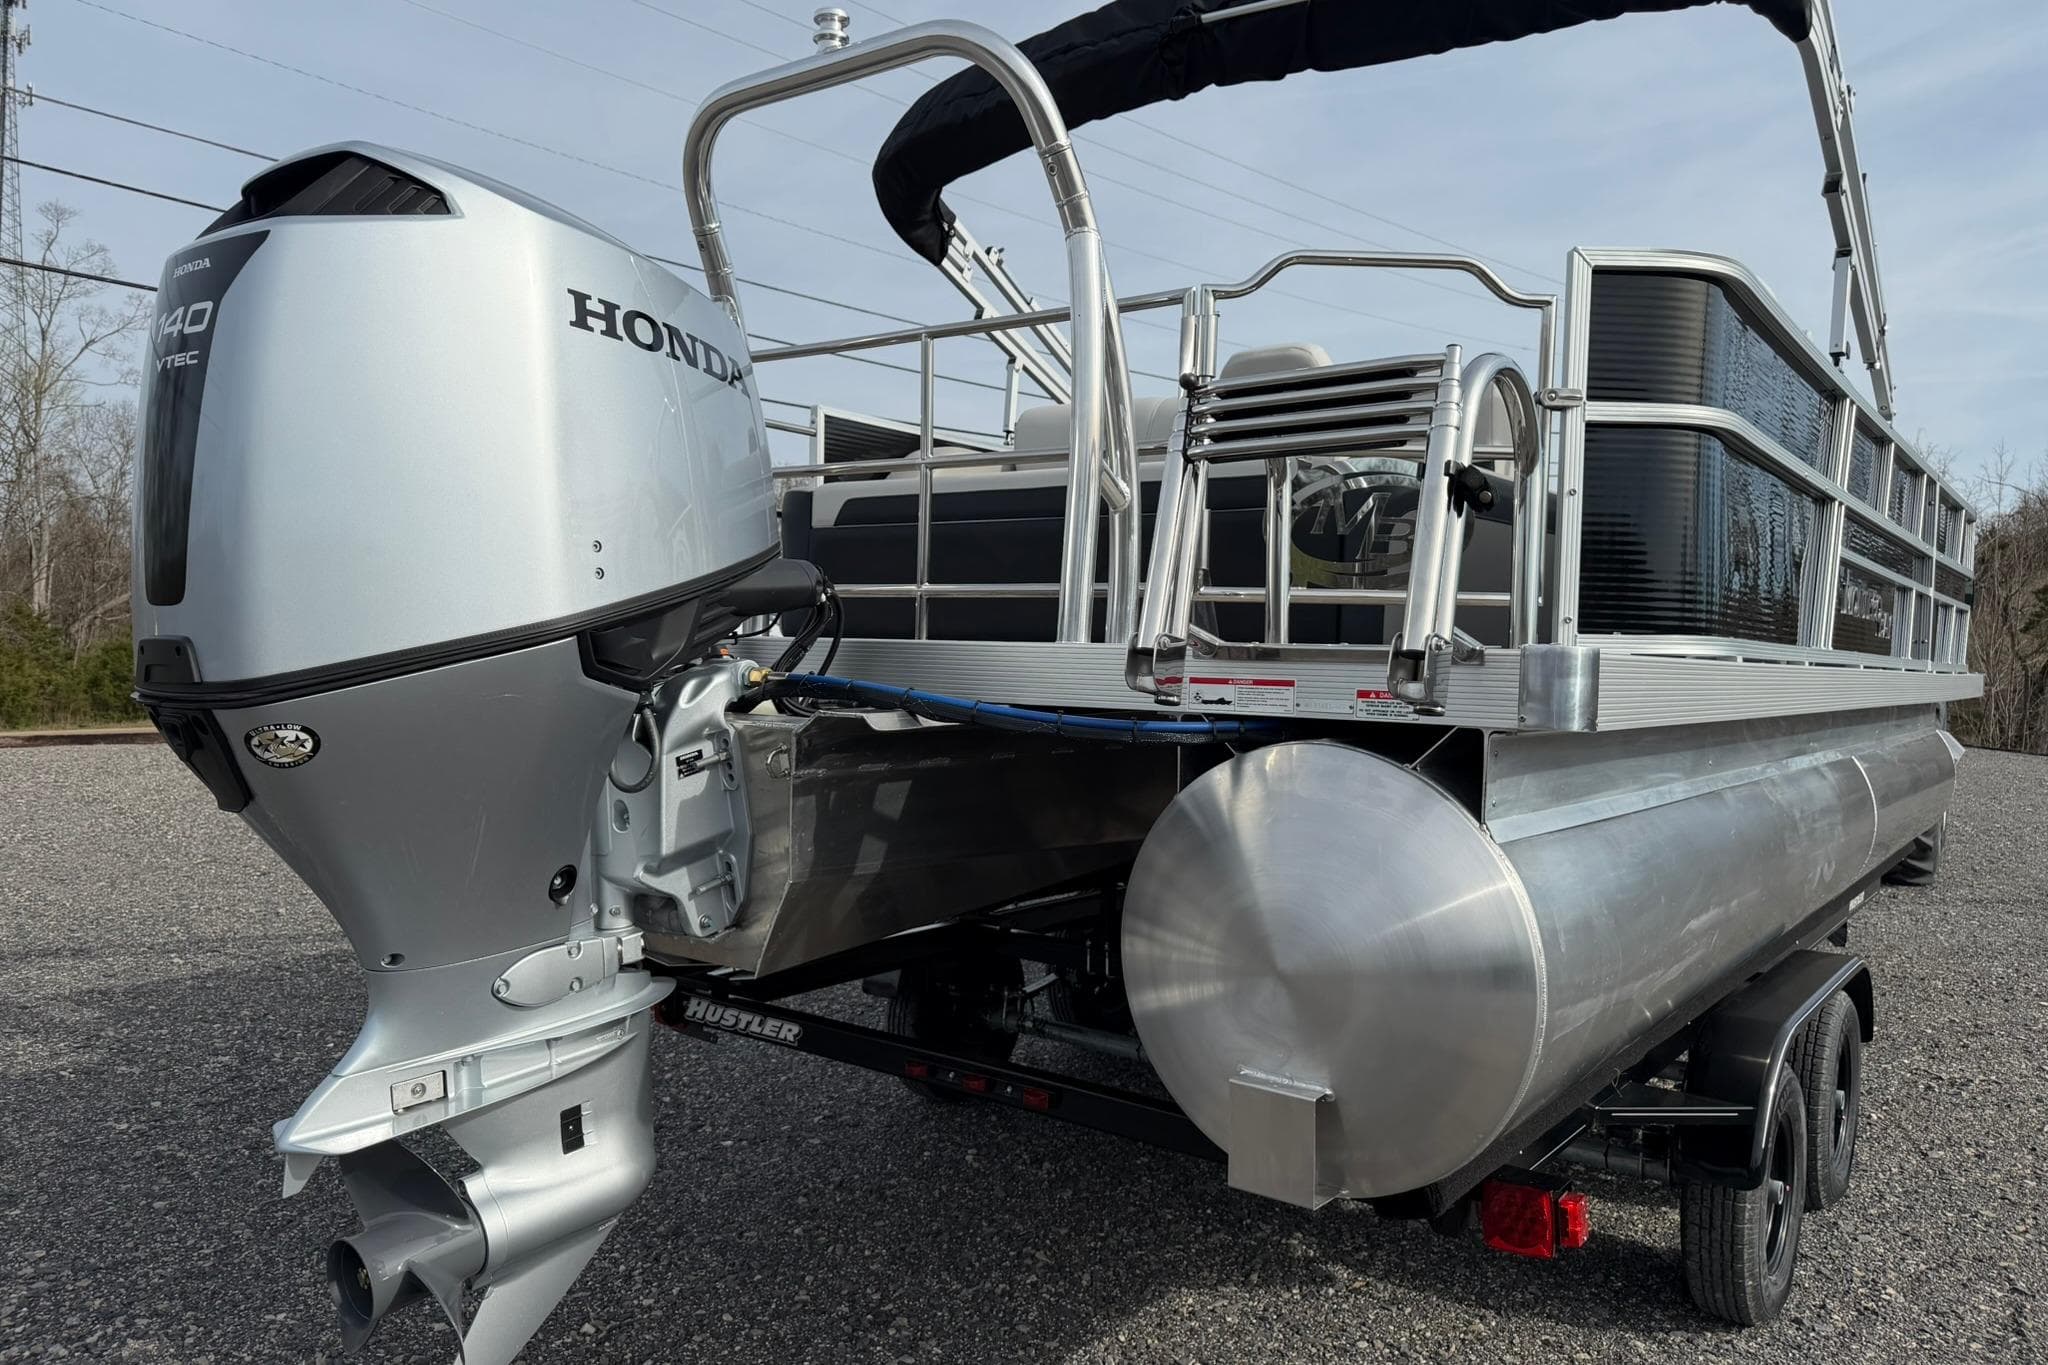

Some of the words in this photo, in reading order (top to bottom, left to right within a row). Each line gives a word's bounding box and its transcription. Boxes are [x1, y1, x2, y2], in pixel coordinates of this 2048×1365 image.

[173, 257, 211, 279] HONDA
[157, 300, 214, 343] 140
[156, 350, 200, 373] VTEC
[567, 287, 751, 400] HONDA
[685, 996, 802, 1045] HUSTLER
